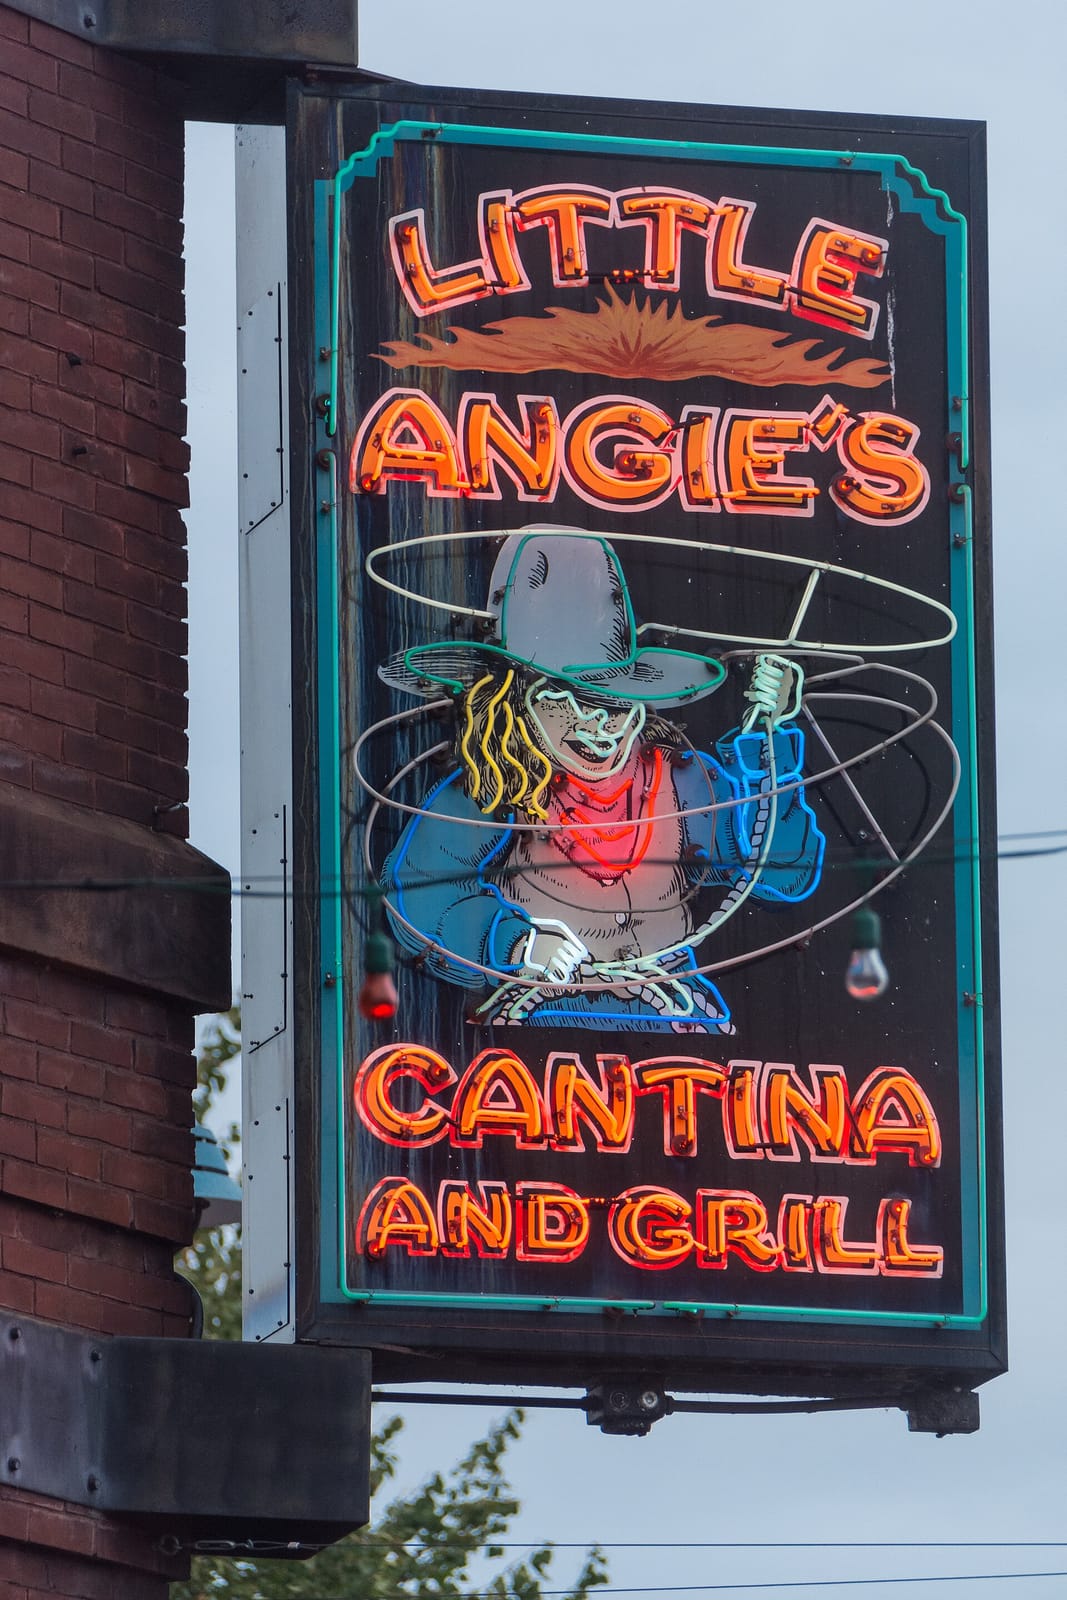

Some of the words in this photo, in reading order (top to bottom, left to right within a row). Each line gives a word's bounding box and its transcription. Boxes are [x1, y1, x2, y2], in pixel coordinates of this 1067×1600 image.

[388, 183, 889, 340] LITTLE
[349, 387, 931, 527] ANGIE'S
[354, 1043, 942, 1168] CANTINA
[356, 1176, 590, 1263] AND
[607, 1184, 943, 1279] GRILL
